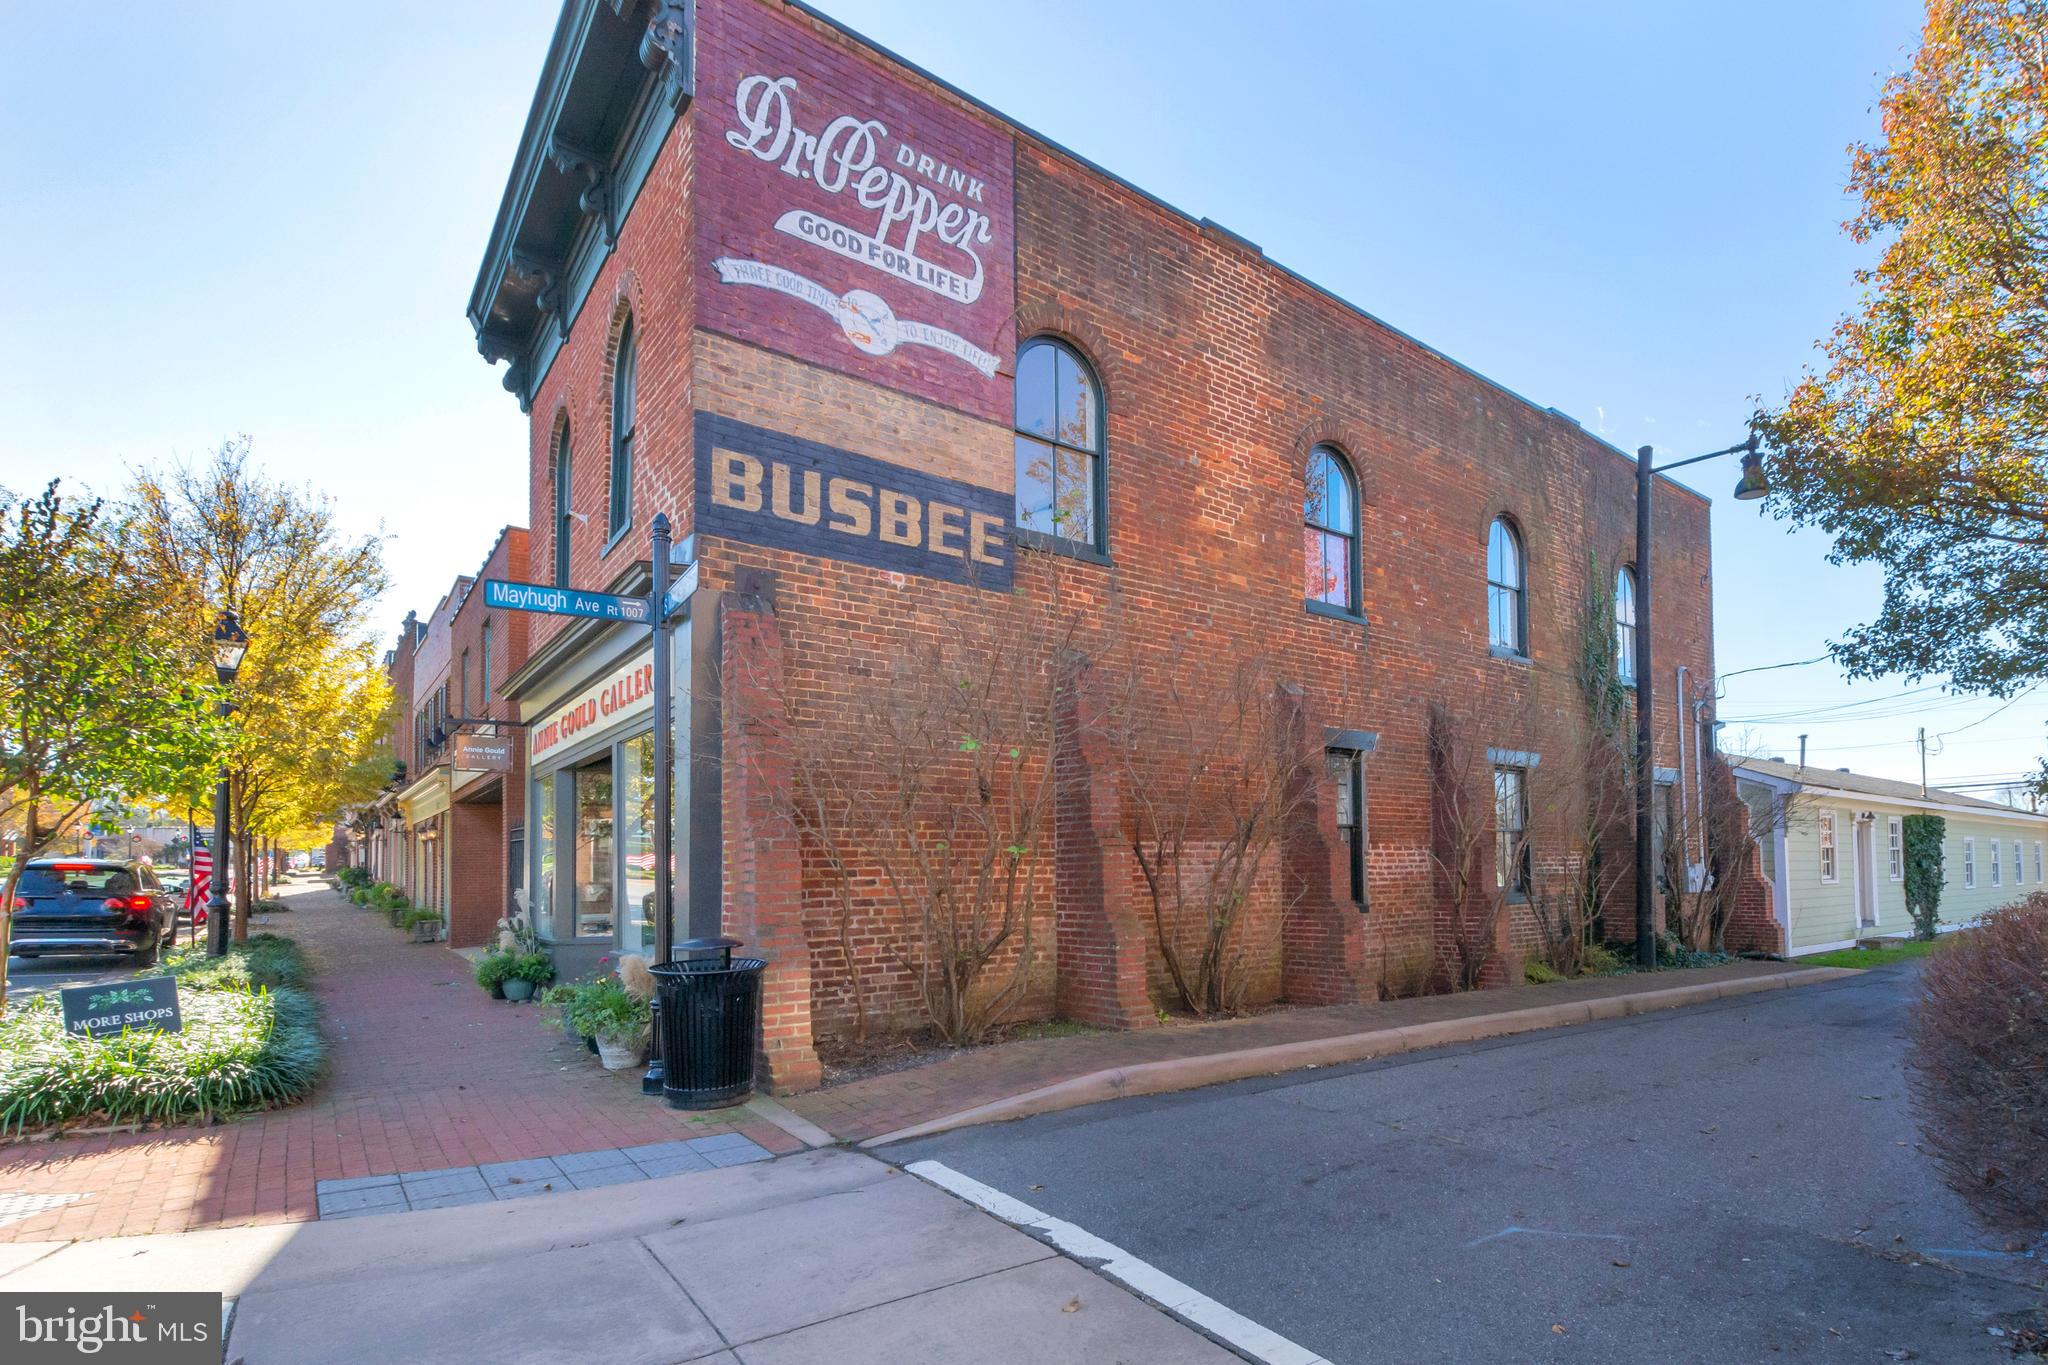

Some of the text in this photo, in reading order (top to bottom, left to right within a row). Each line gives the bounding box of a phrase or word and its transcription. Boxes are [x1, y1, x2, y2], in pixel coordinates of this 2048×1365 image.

[896, 143, 985, 203] DRINK
[734, 262, 774, 284] THREE
[775, 272, 803, 294] GOOD
[798, 214, 969, 300] GOOD FOR LIFE!
[711, 446, 1006, 567] BUSBEE
[493, 582, 644, 618] Mayhugh Ave Rt 1007
[532, 663, 654, 756] ANNIE GOULD GALLER
[73, 1006, 174, 1031] MORE SHOPS
